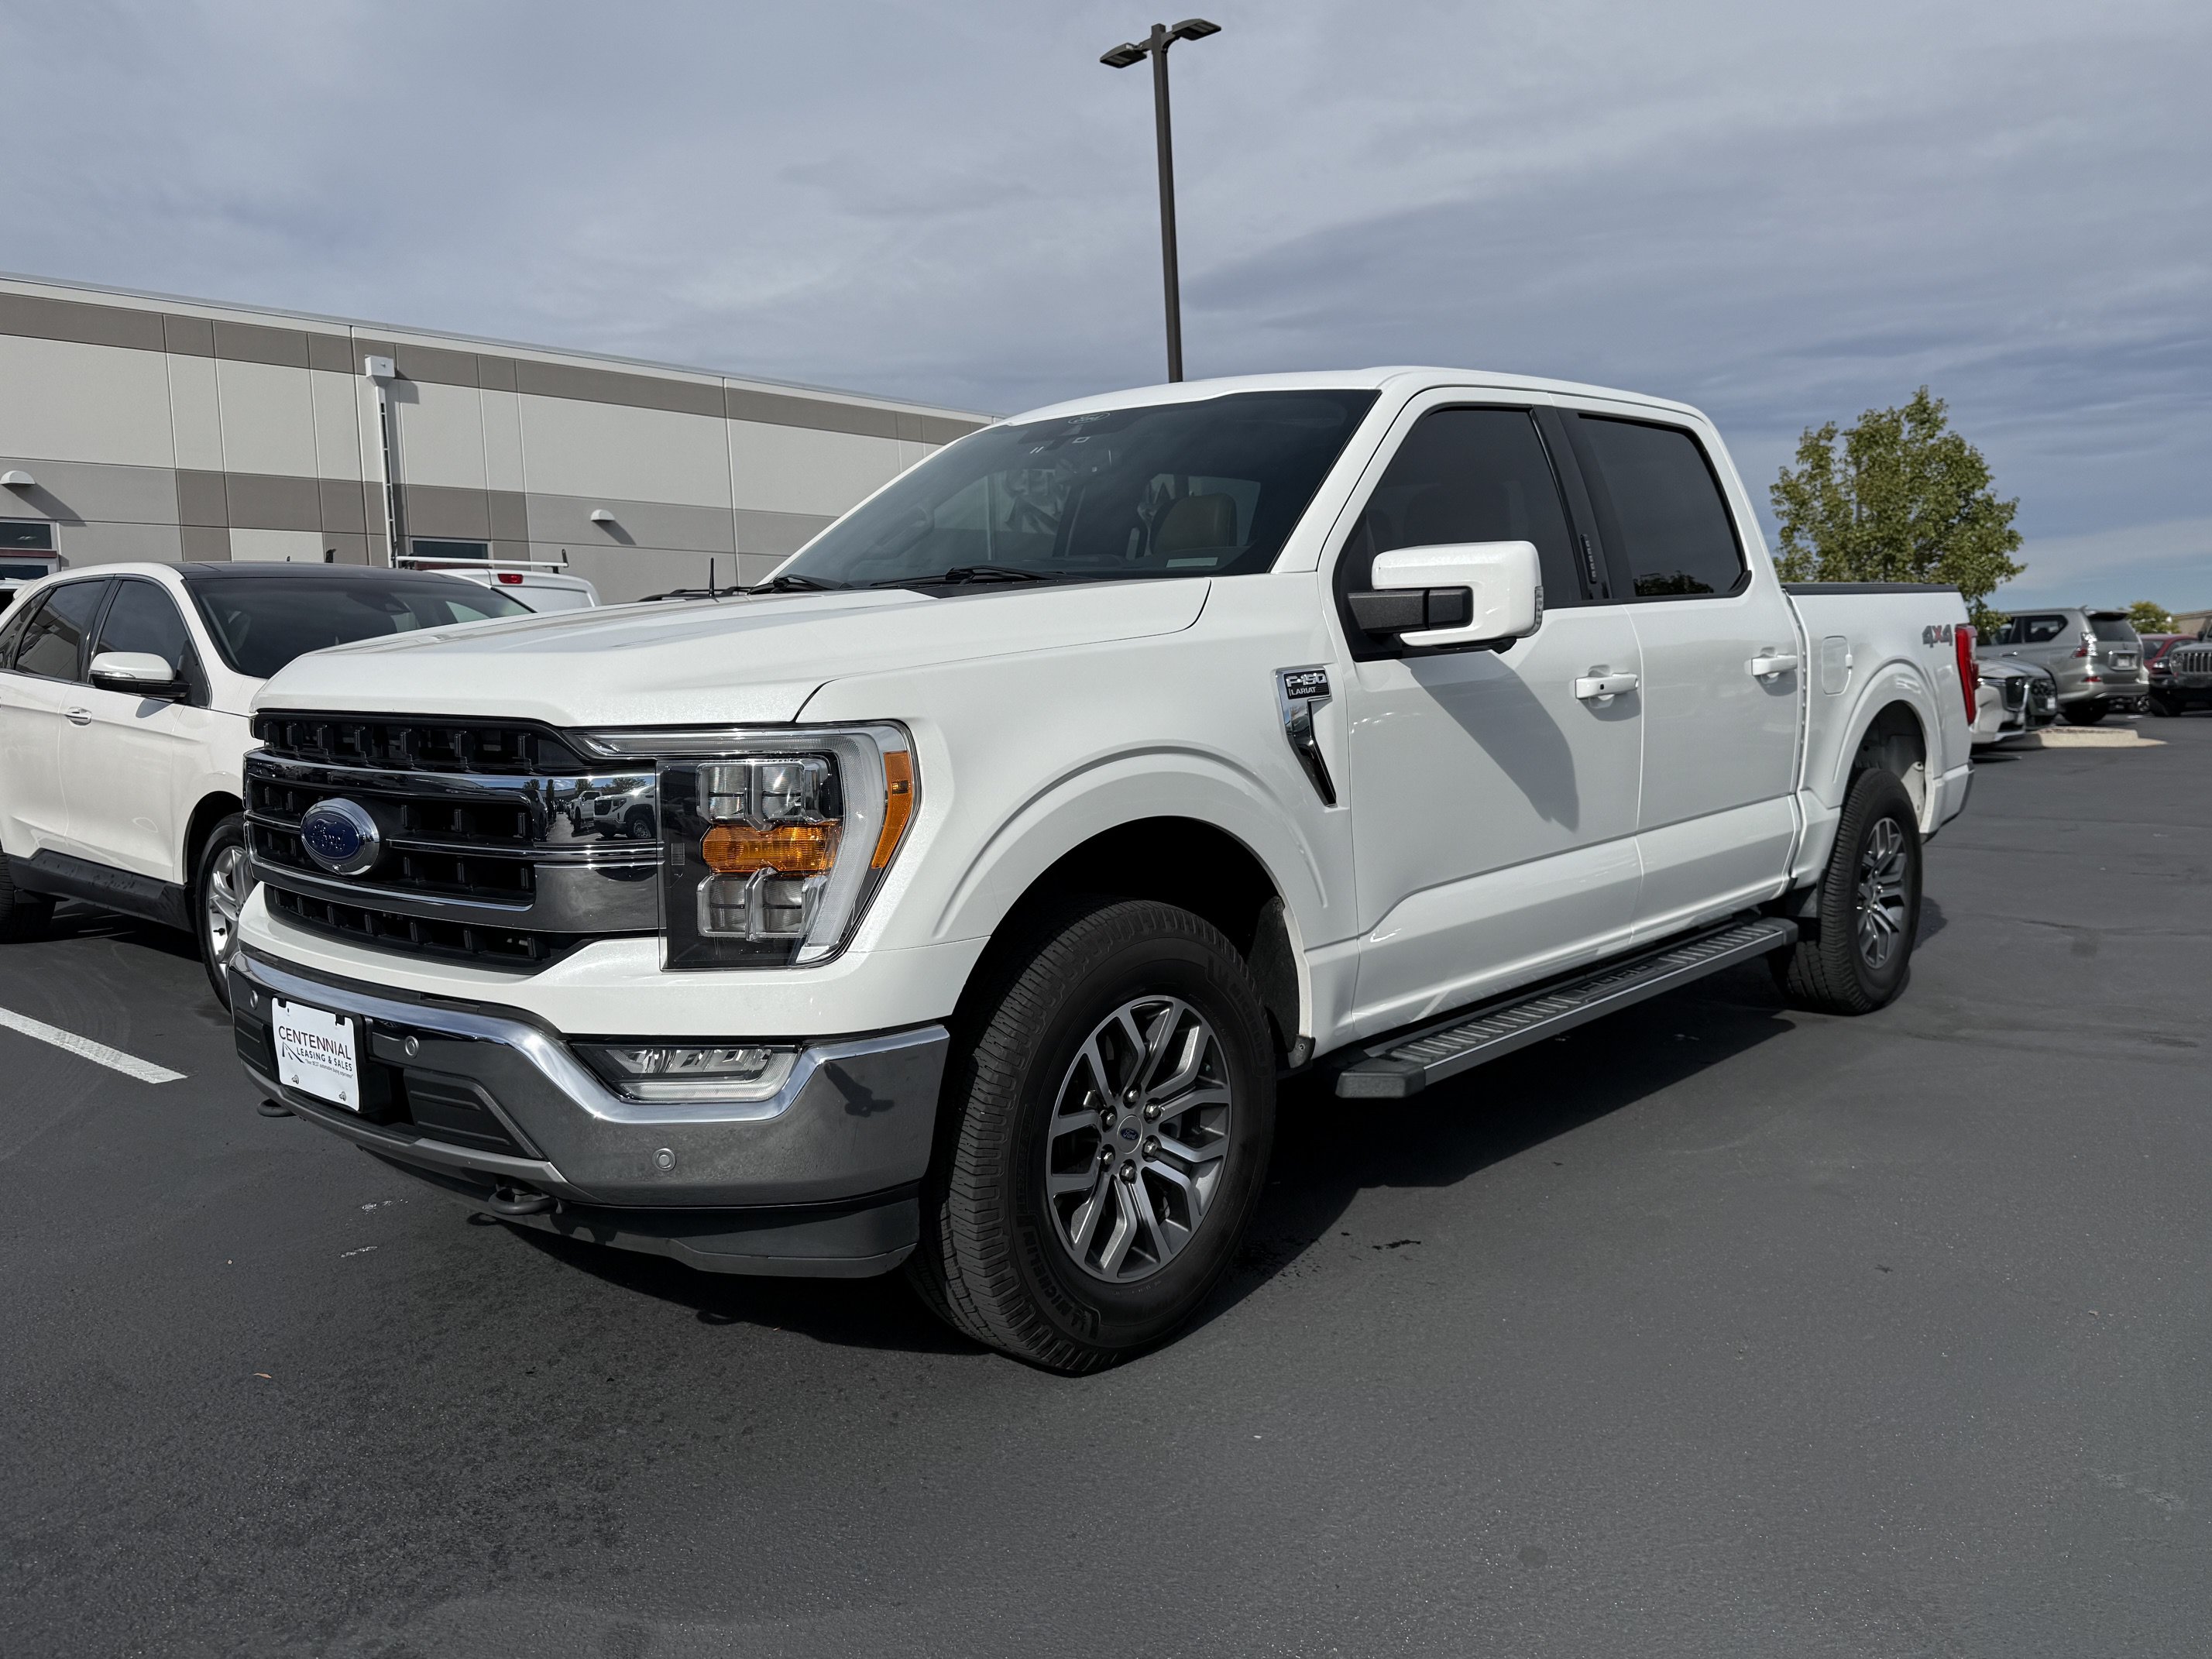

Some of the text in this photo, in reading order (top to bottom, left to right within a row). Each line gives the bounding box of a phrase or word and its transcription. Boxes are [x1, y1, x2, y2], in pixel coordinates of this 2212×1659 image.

[1286, 672, 1328, 688] F-150
[1291, 687, 1317, 696] LARIAT
[278, 1025, 352, 1060] CENTENNIAL
[296, 1047, 352, 1071] LEASING & SALES
[1122, 1128, 1138, 1140] Ford
